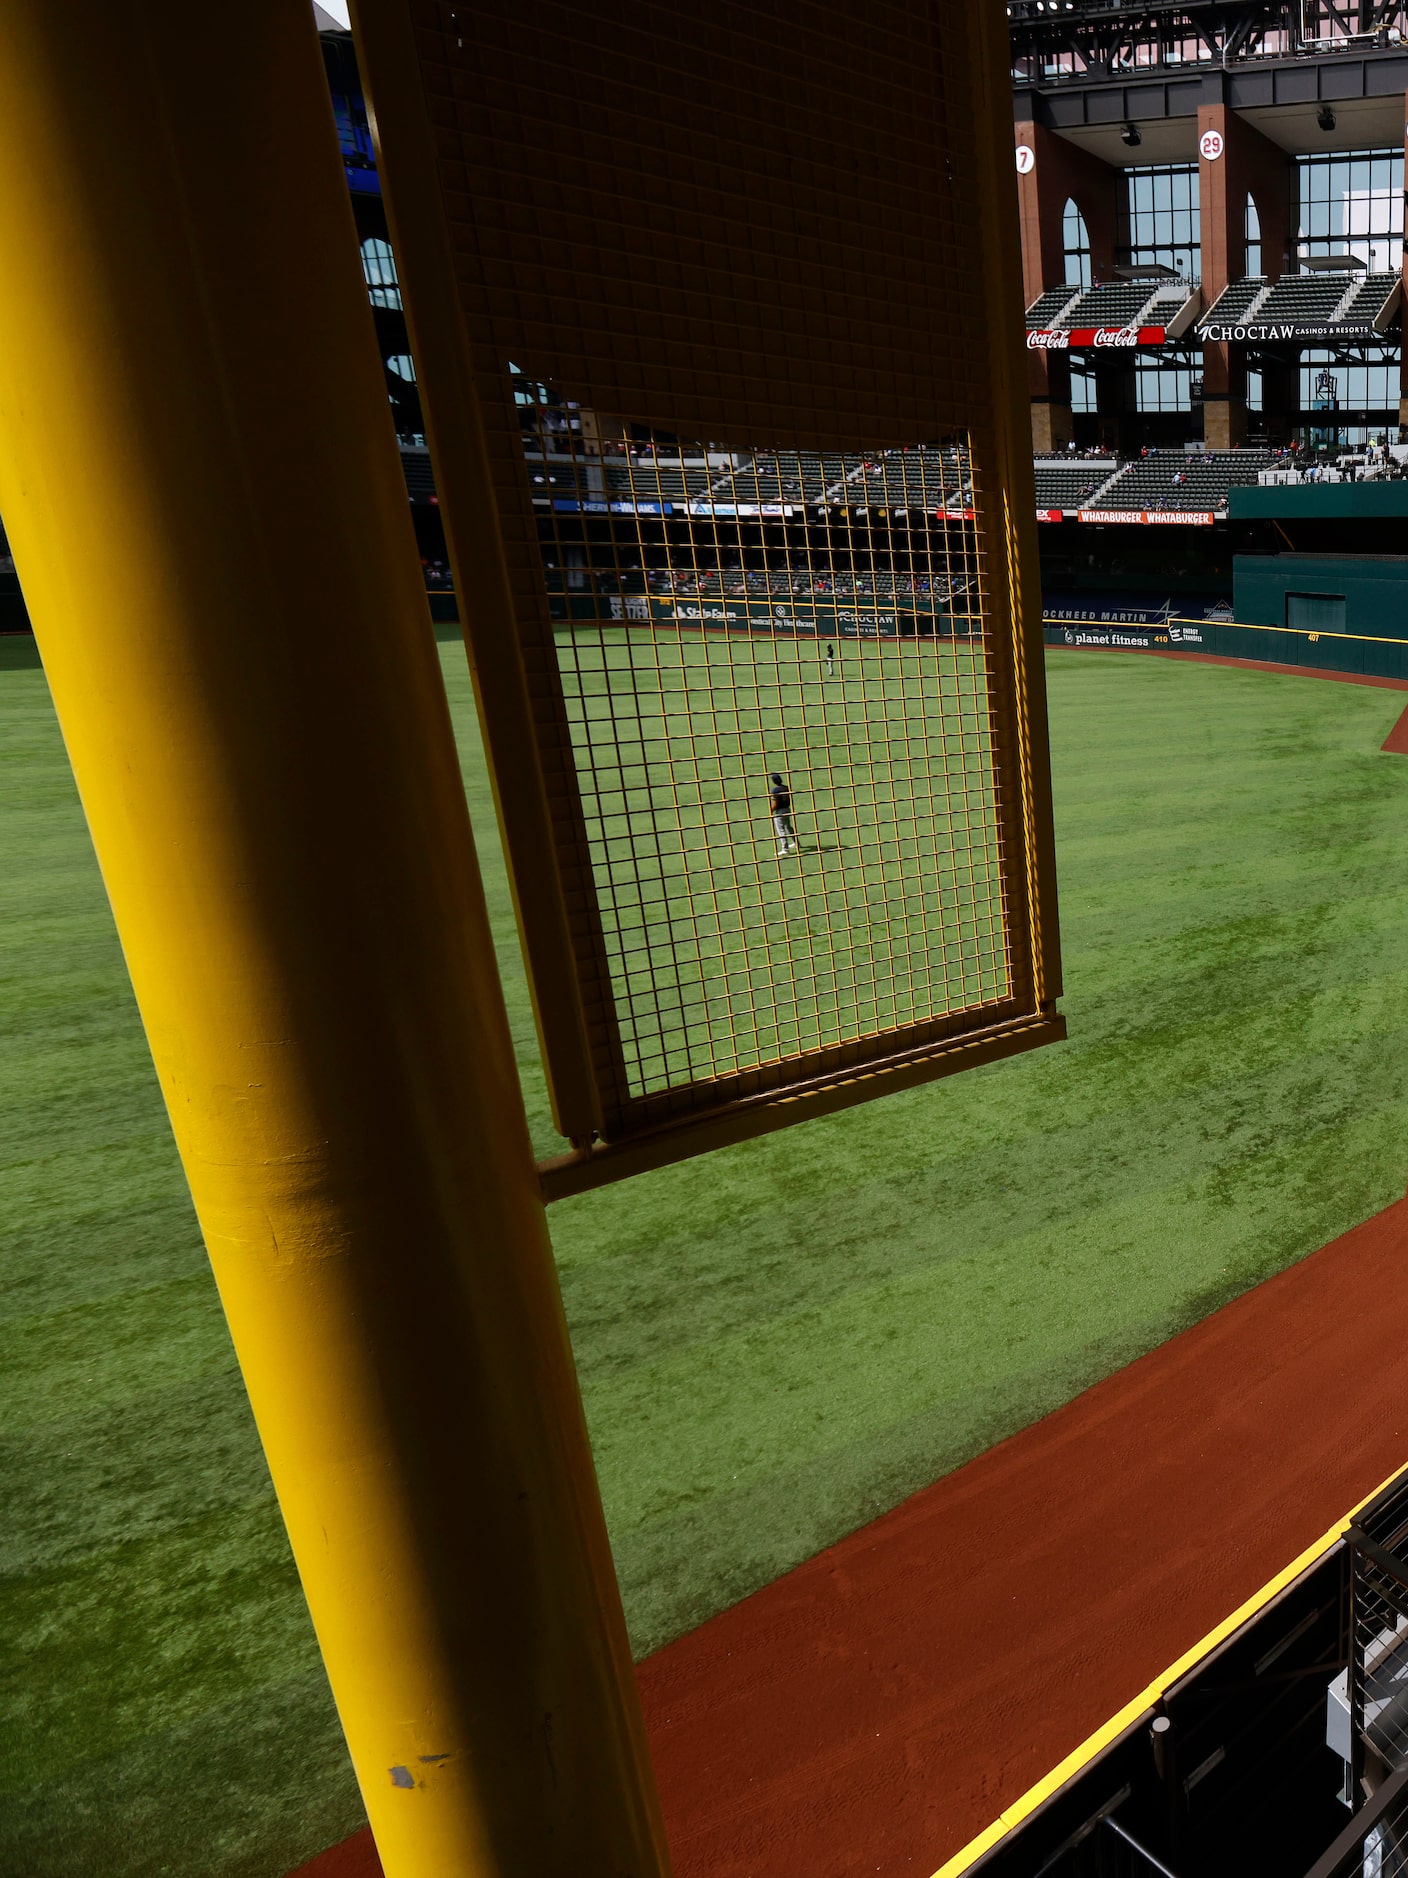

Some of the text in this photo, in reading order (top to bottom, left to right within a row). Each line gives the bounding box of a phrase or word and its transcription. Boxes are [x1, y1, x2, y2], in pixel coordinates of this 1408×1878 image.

[1203, 137, 1221, 153] 29
[1019, 152, 1028, 168] 7
[1208, 325, 1294, 341] CHOCTAW
[1081, 512, 1208, 523] WHATABURGER WHATABURGER
[1042, 610, 1146, 622] OCKHEED MARTIN
[1075, 633, 1149, 646] planet fitness
[1308, 634, 1320, 642] 407
